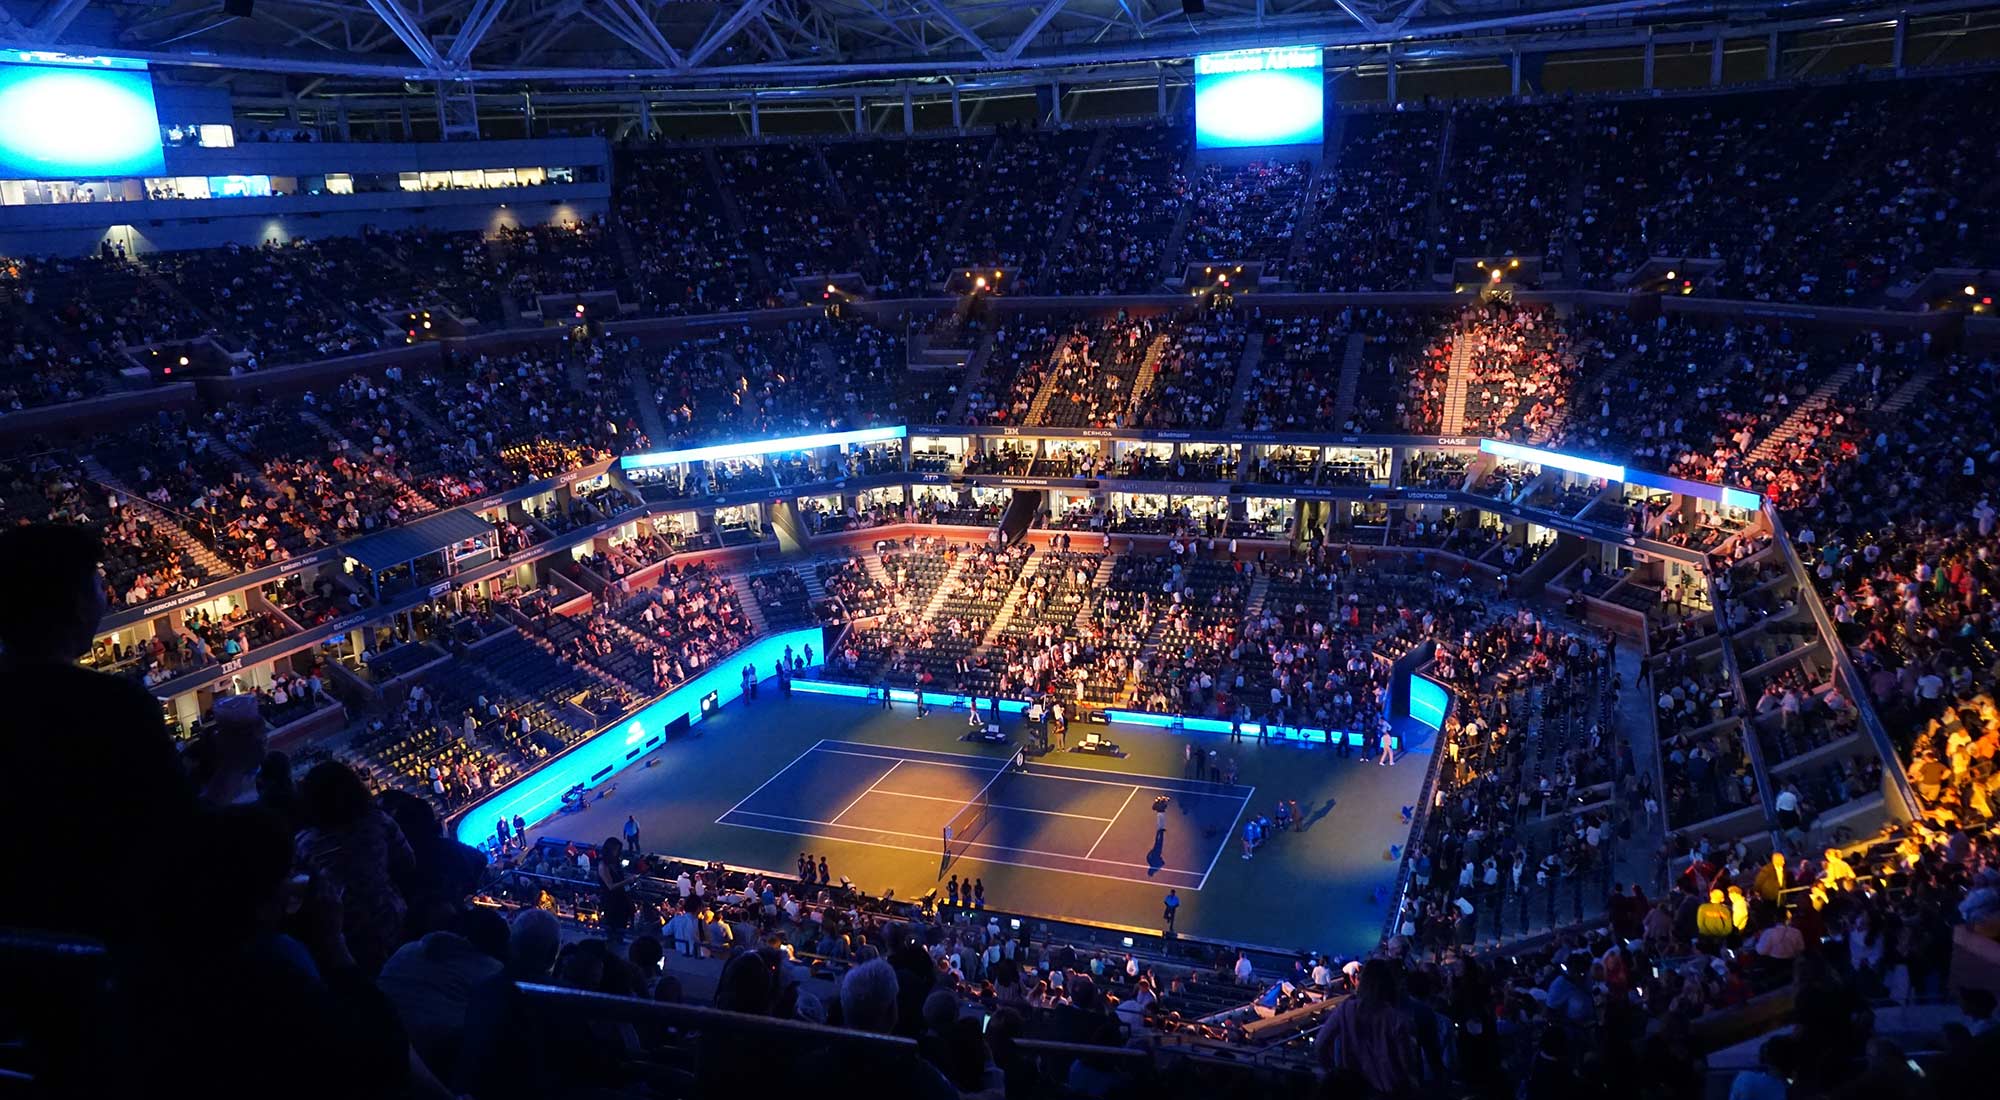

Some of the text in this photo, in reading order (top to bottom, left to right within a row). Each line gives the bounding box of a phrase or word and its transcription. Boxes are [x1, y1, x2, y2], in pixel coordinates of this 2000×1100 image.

[560, 473, 577, 483] CHASE
[144, 591, 207, 615] AMERICAN EXPRESS
[333, 615, 365, 630] BERMUDA
[221, 658, 242, 674] IBM
